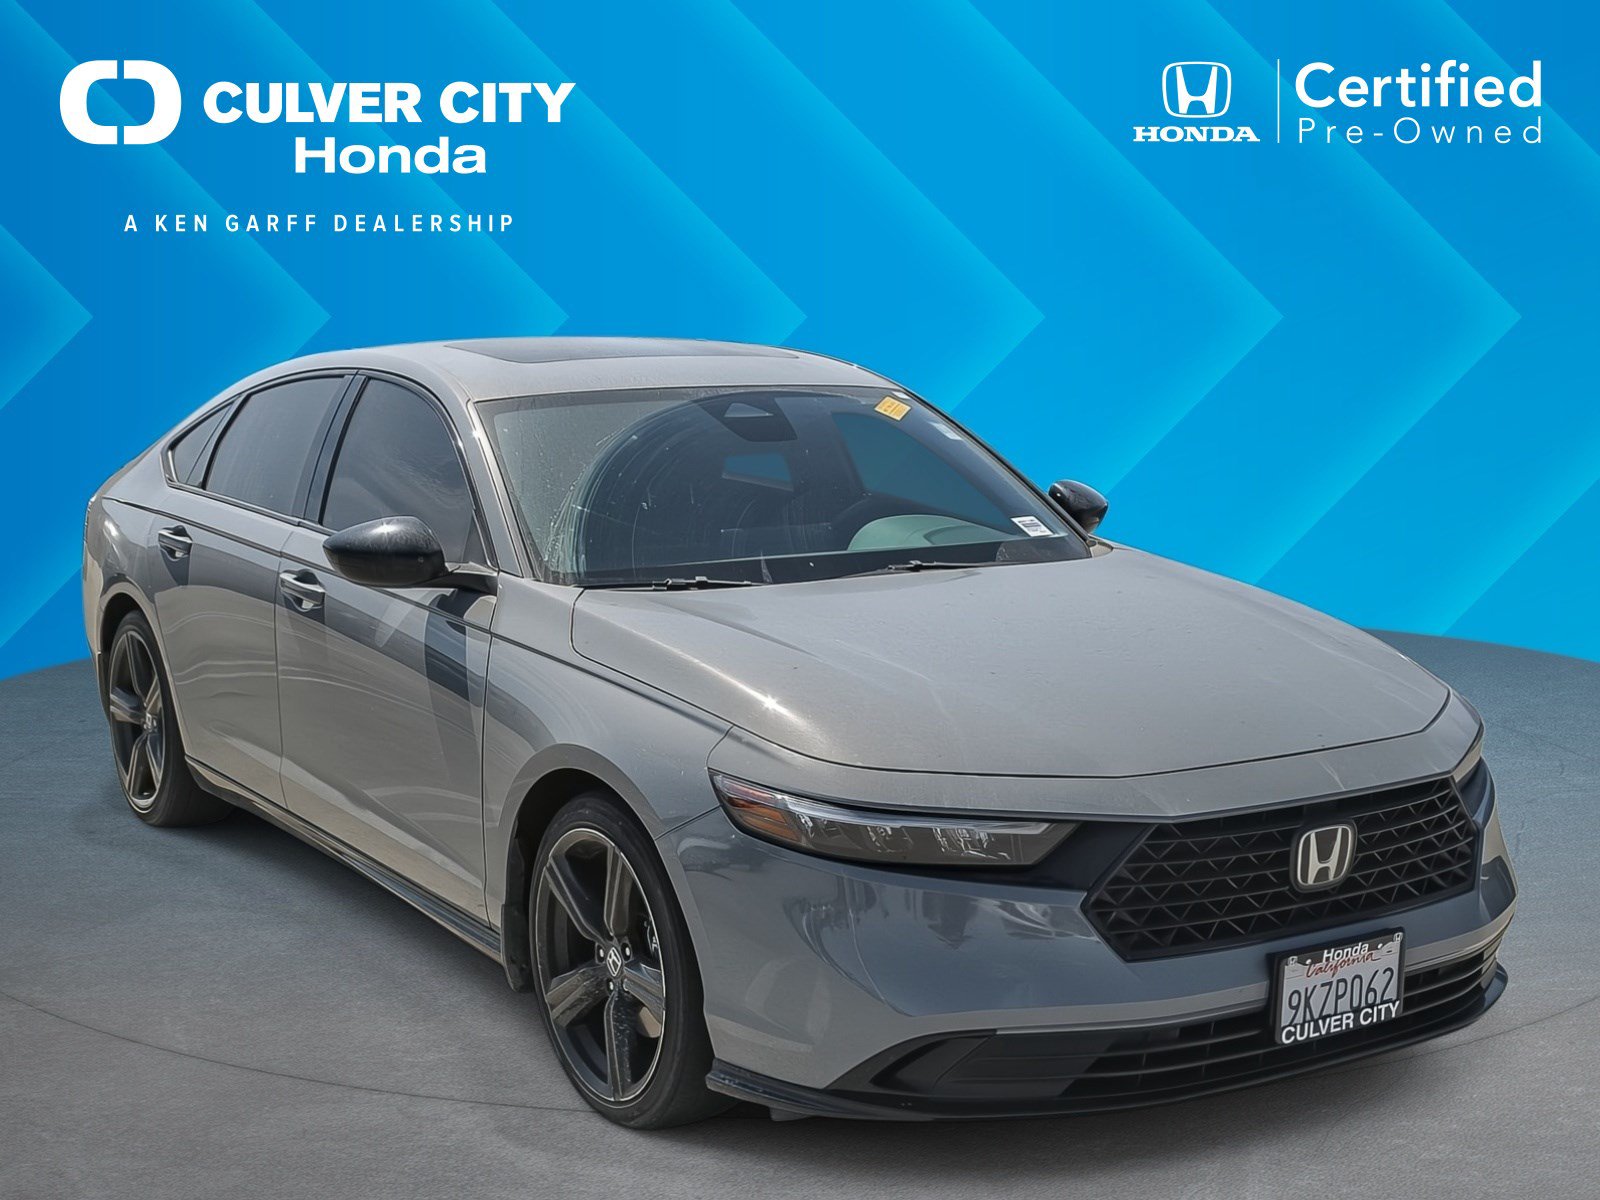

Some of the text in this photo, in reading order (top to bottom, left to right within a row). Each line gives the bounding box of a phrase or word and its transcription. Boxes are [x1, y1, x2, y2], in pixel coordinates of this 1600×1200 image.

[1306, 951, 1381, 978] California
[1322, 942, 1369, 963] Honda
[1288, 967, 1395, 1025] 9KZP062
[1281, 1000, 1400, 1044] CULVER CITY
